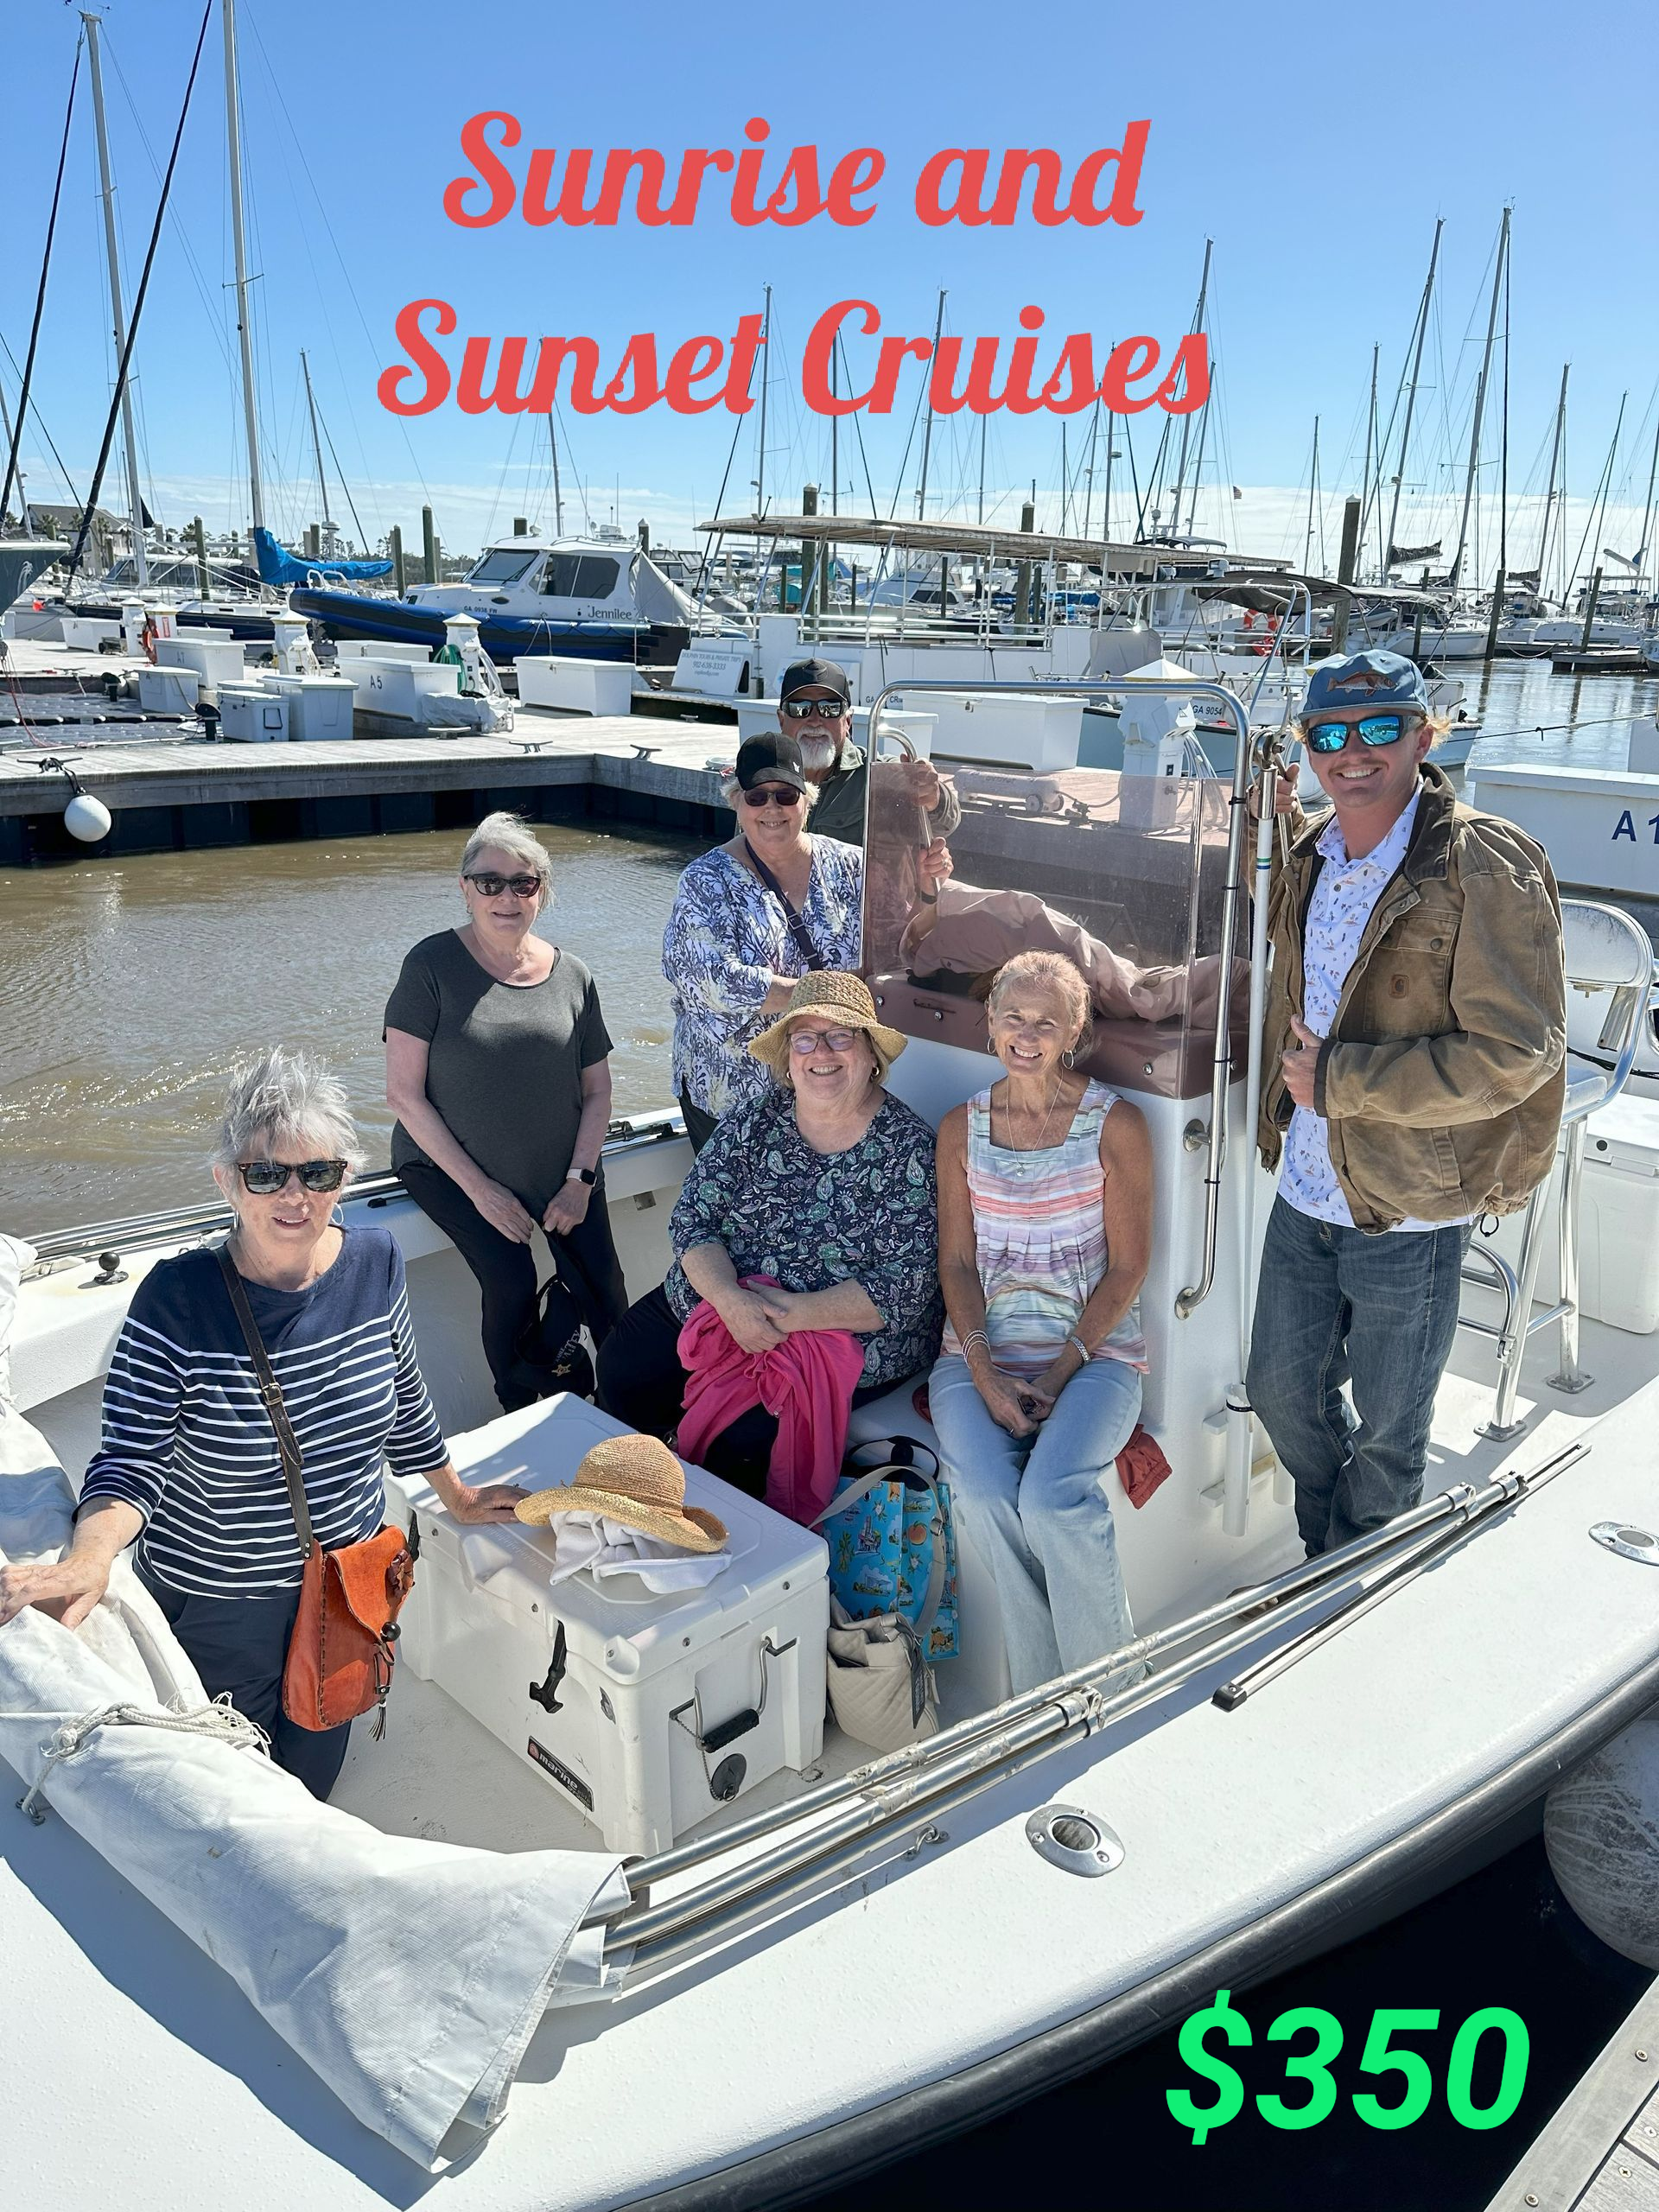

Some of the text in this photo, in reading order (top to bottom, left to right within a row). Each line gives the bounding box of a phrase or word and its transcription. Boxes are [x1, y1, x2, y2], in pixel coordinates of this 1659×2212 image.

[588, 606, 632, 620] Jennilee
[1192, 705, 1223, 715] GA 9054
[538, 1752, 578, 1791] marine
